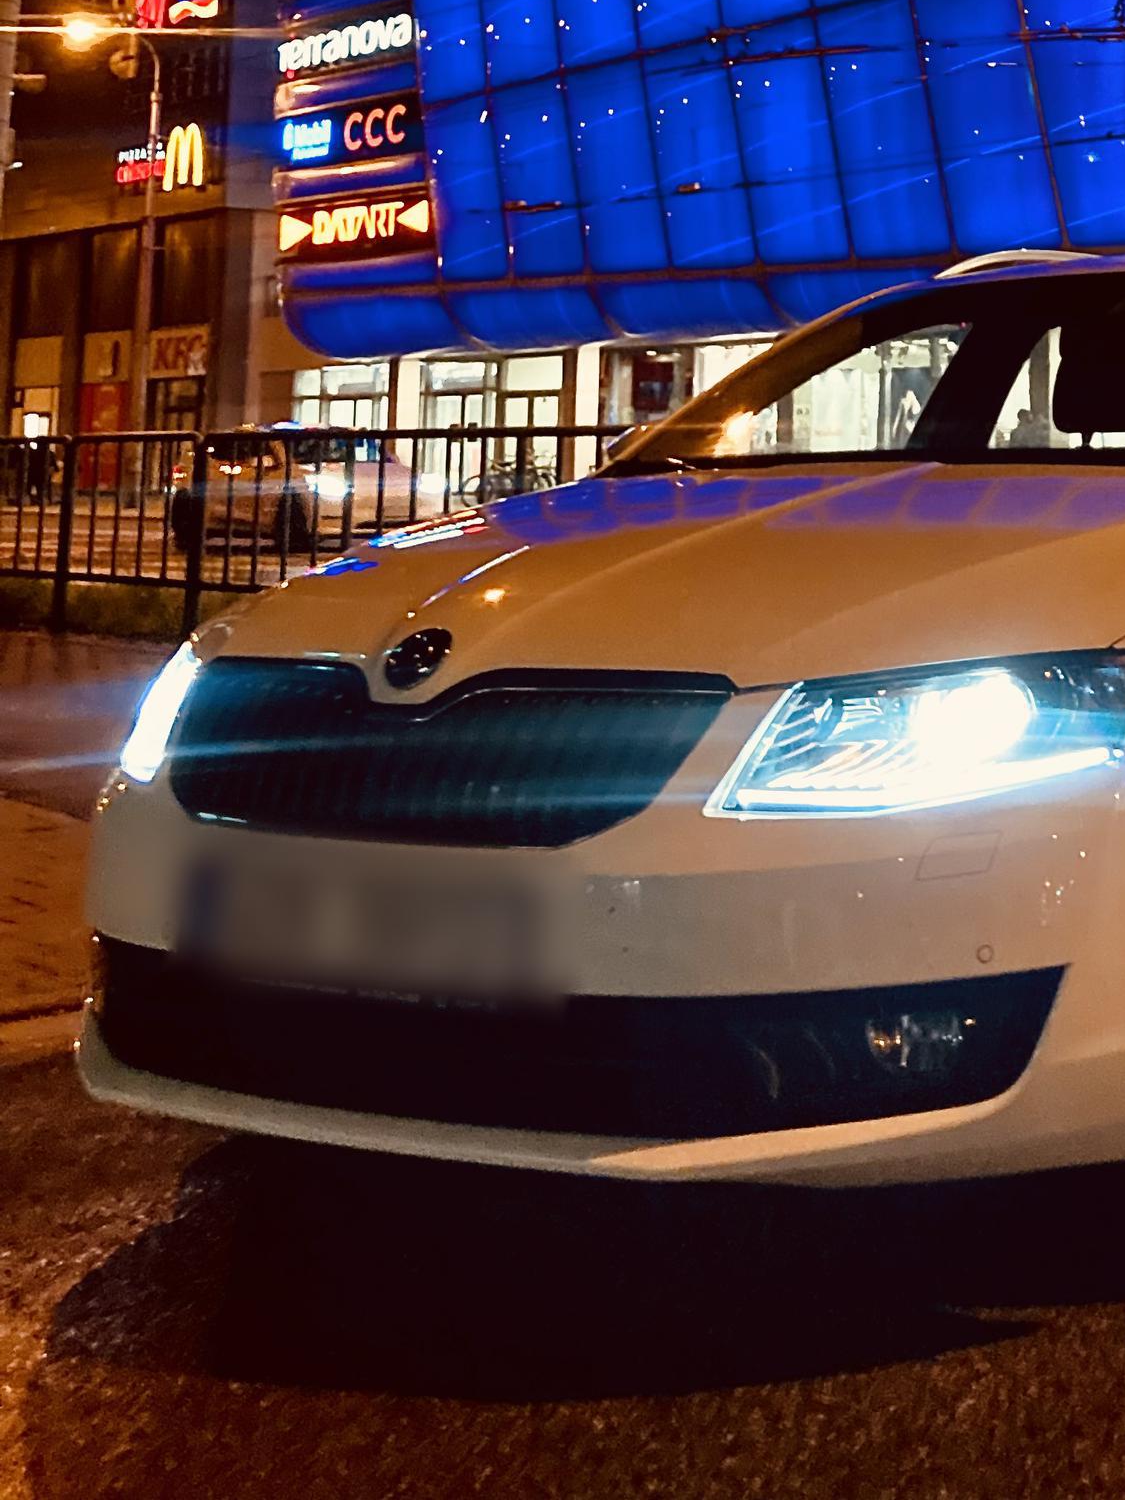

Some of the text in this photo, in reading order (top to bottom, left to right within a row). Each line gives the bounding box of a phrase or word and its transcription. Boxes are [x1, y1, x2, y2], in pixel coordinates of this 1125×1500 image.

[278, 13, 412, 71] Terranova
[343, 104, 407, 151] CCC
[312, 201, 405, 245] DATART
[153, 333, 207, 370] KFC
